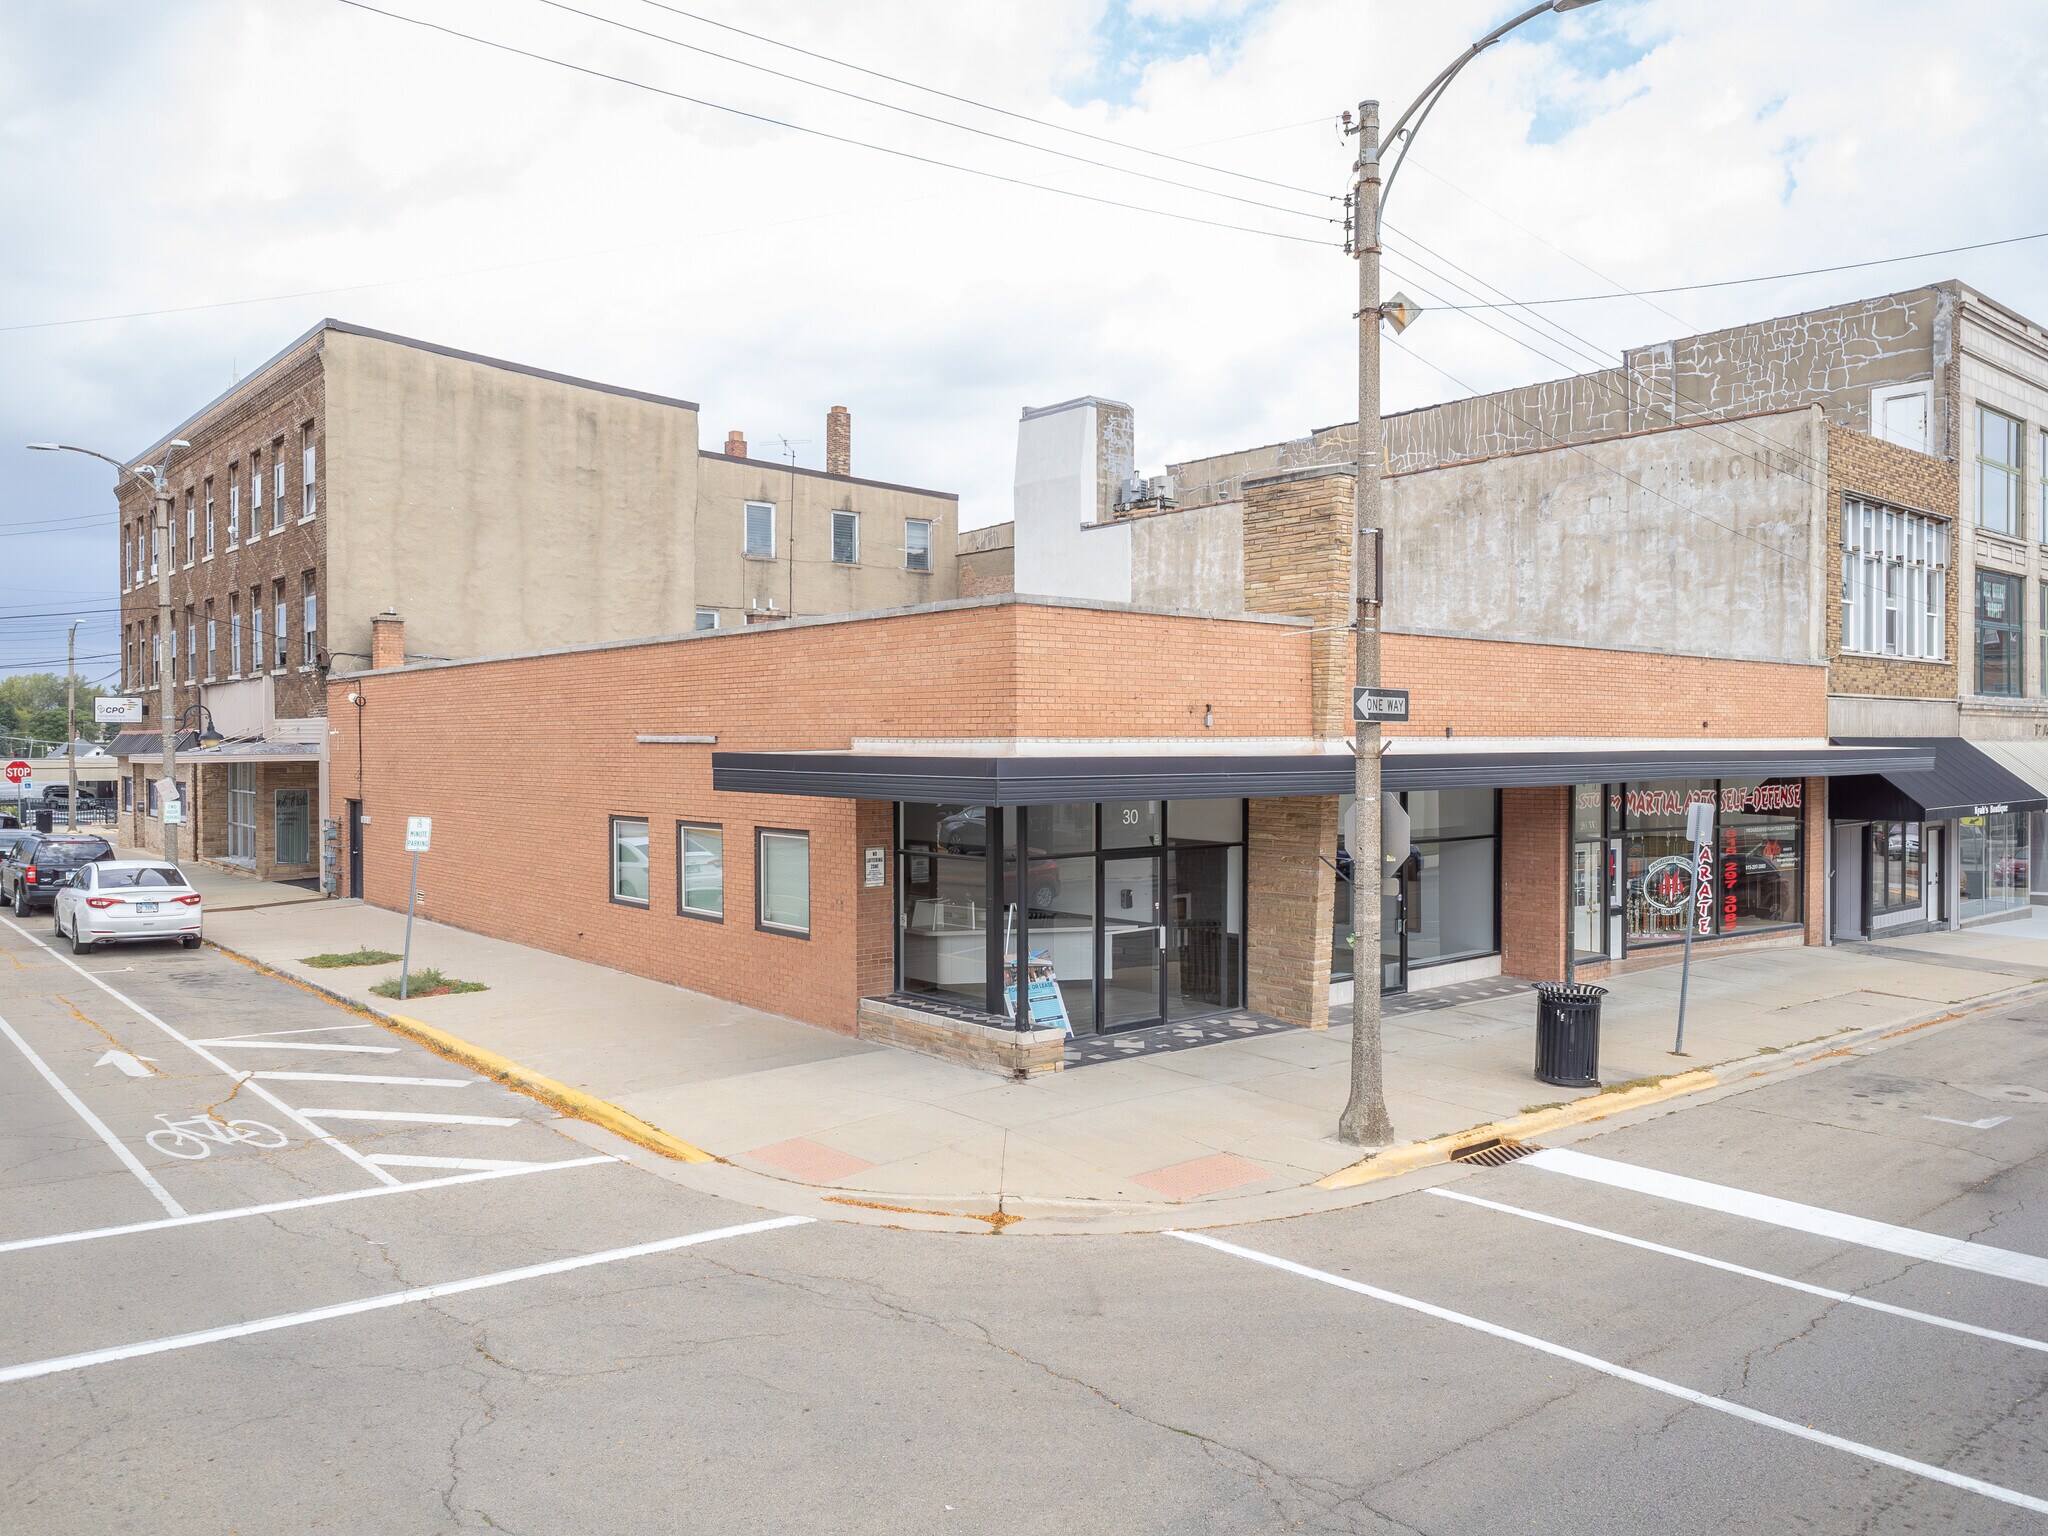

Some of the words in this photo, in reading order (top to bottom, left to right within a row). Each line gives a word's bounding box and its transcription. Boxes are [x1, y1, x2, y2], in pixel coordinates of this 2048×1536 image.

[105, 706, 125, 714] CPO
[1366, 698, 1384, 712] ONE
[1386, 699, 1404, 712] WAY
[6, 767, 30, 777] STOP
[1626, 789, 1683, 818] MARTIAL
[1720, 784, 1802, 813] SELF-DEFENSE
[1122, 809, 1139, 825] 30
[1724, 862, 1738, 889] 297
[1697, 840, 1713, 935] ARATE
